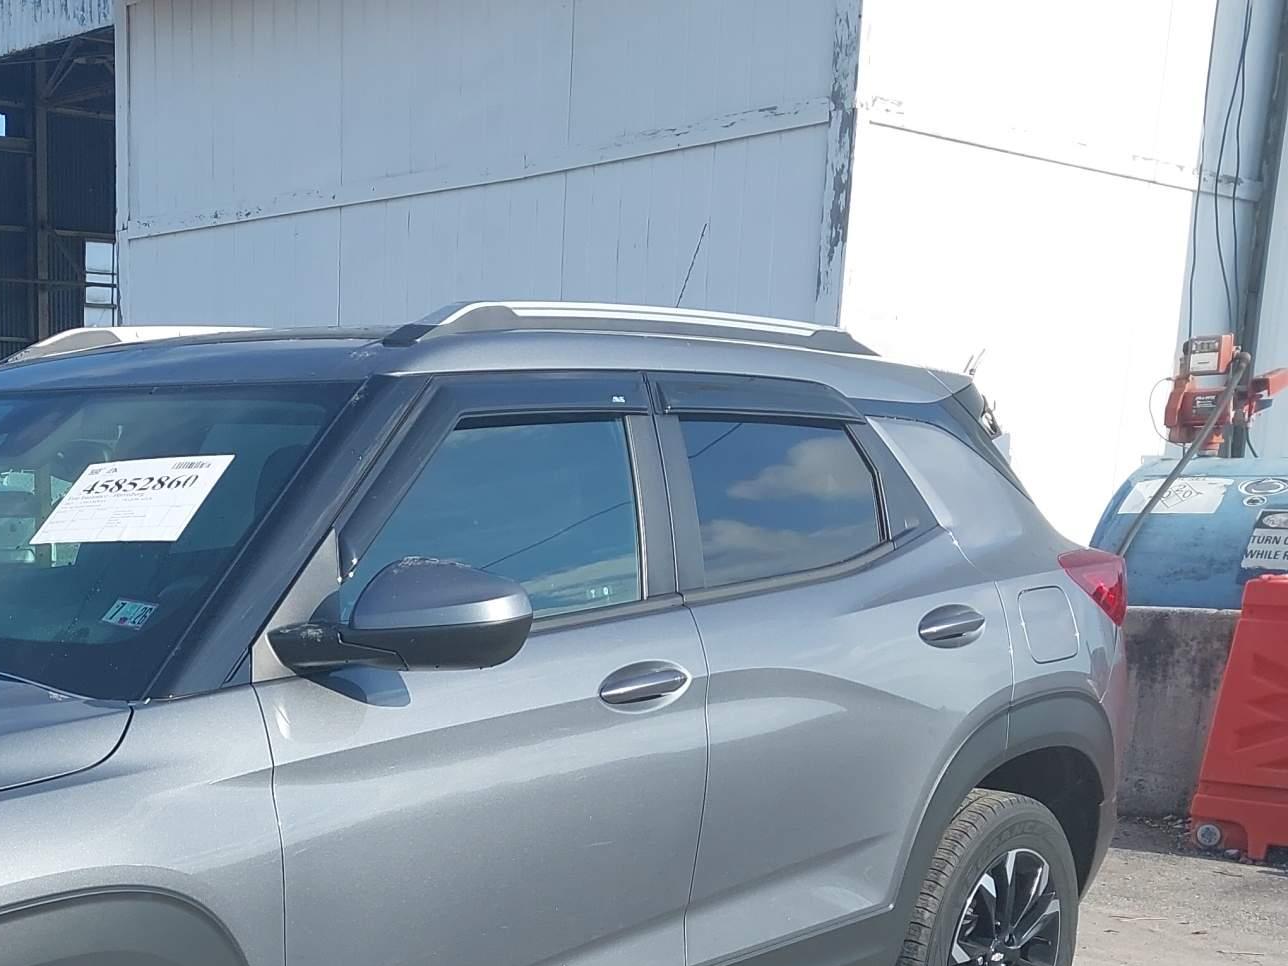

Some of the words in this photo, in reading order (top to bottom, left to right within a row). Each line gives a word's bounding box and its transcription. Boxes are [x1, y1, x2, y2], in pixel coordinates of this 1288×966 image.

[82, 474, 200, 495] 45852860
[1251, 535, 1282, 545] TURN
[1245, 549, 1281, 560] WHILE
